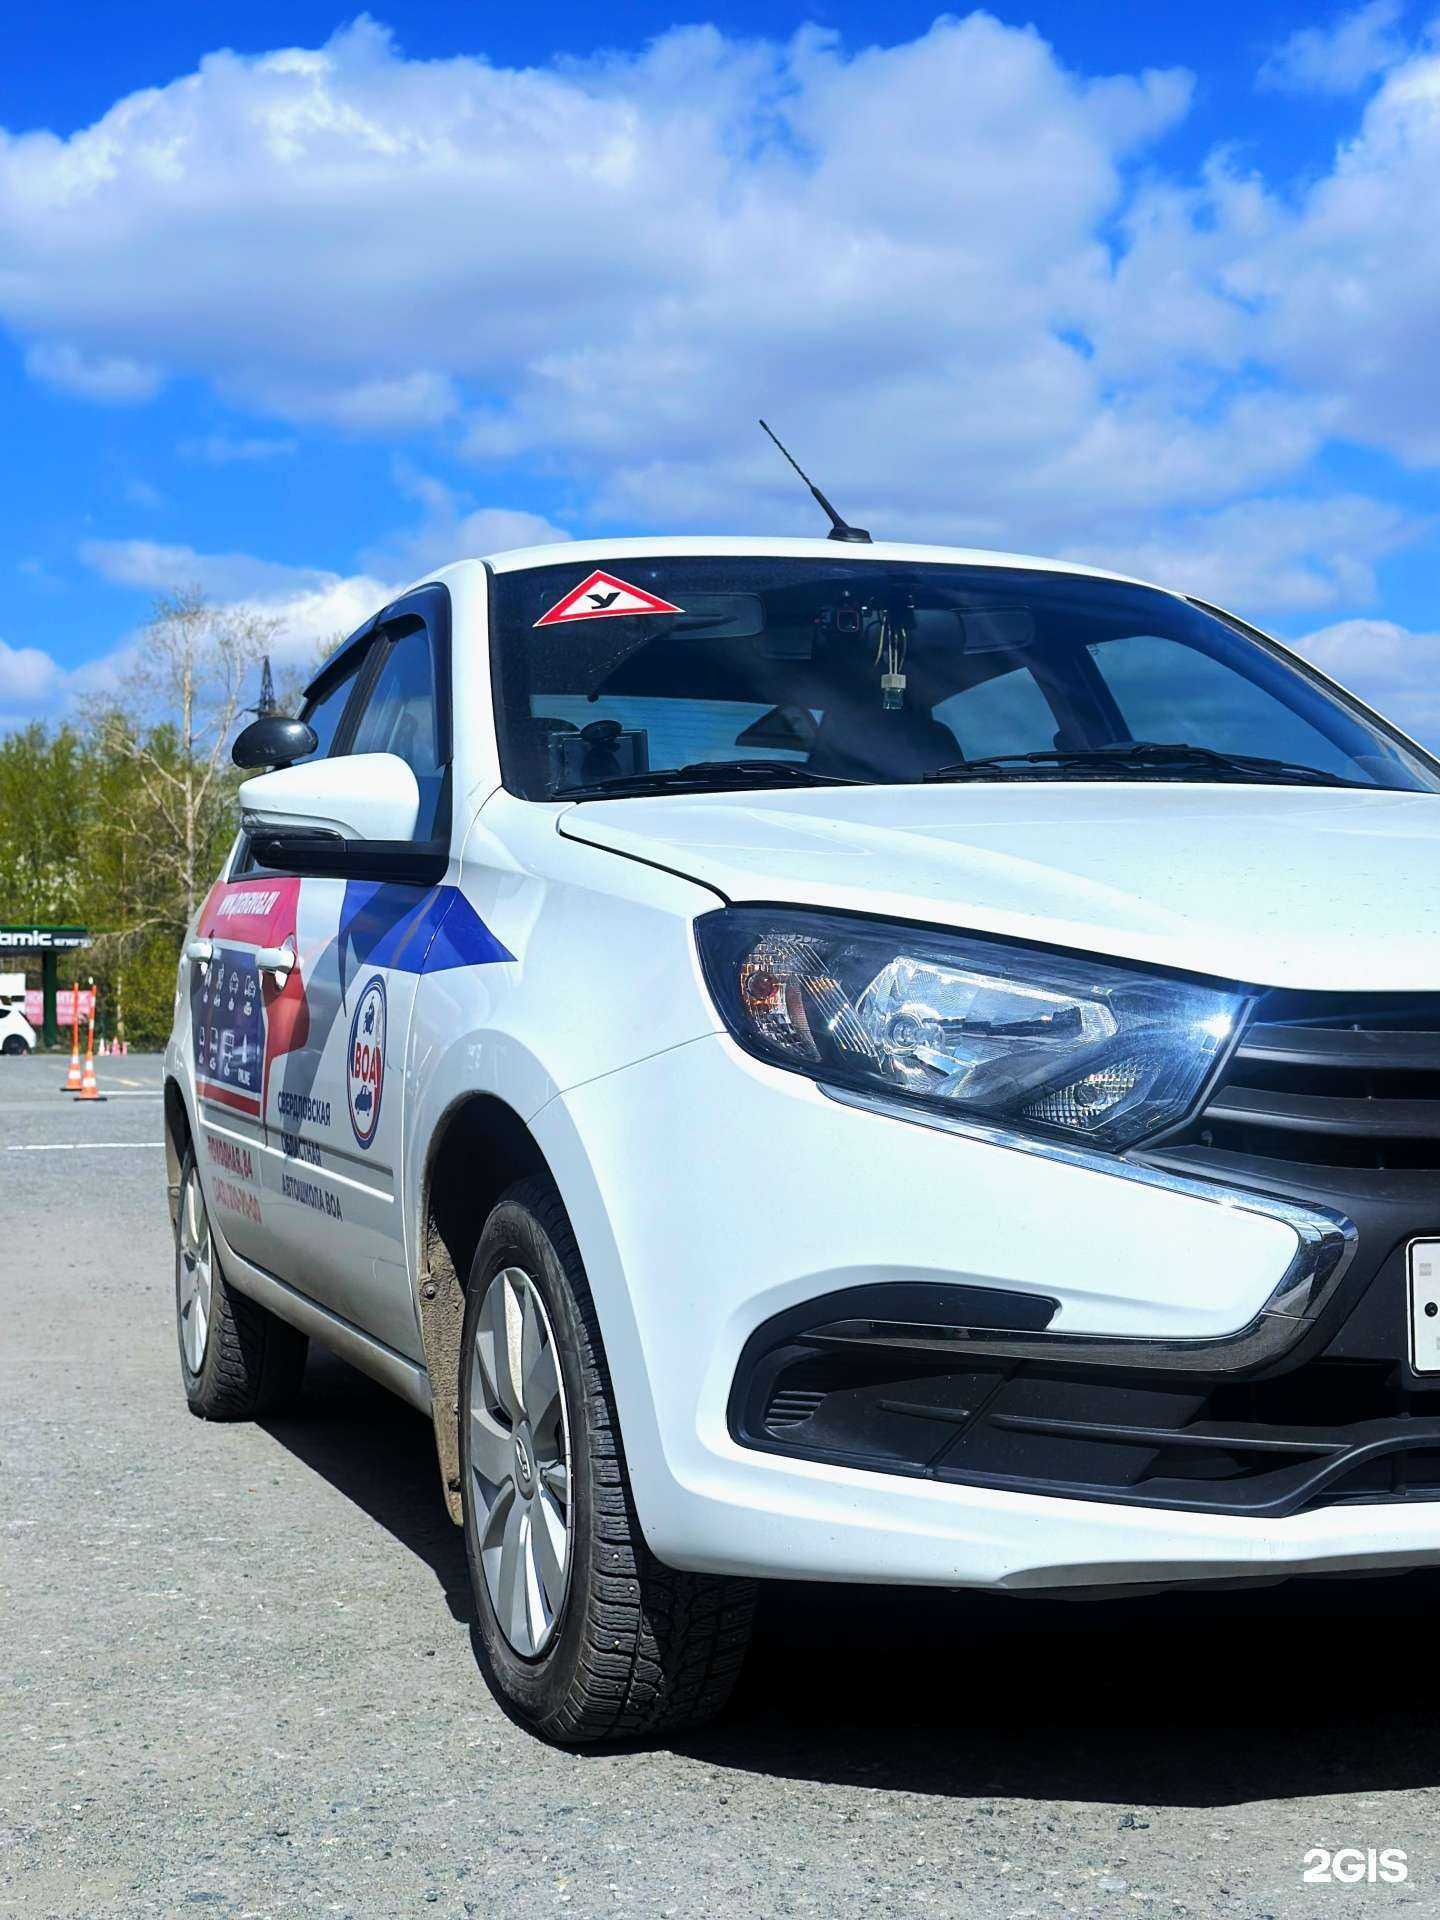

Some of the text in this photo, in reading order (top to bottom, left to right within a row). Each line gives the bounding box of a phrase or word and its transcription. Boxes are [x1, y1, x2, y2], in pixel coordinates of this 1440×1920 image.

[0, 930, 52, 946] amic
[278, 1091, 331, 1127] СВЕРДЛОВСКАЯ
[282, 1174, 325, 1212] АВТОШКОЛА
